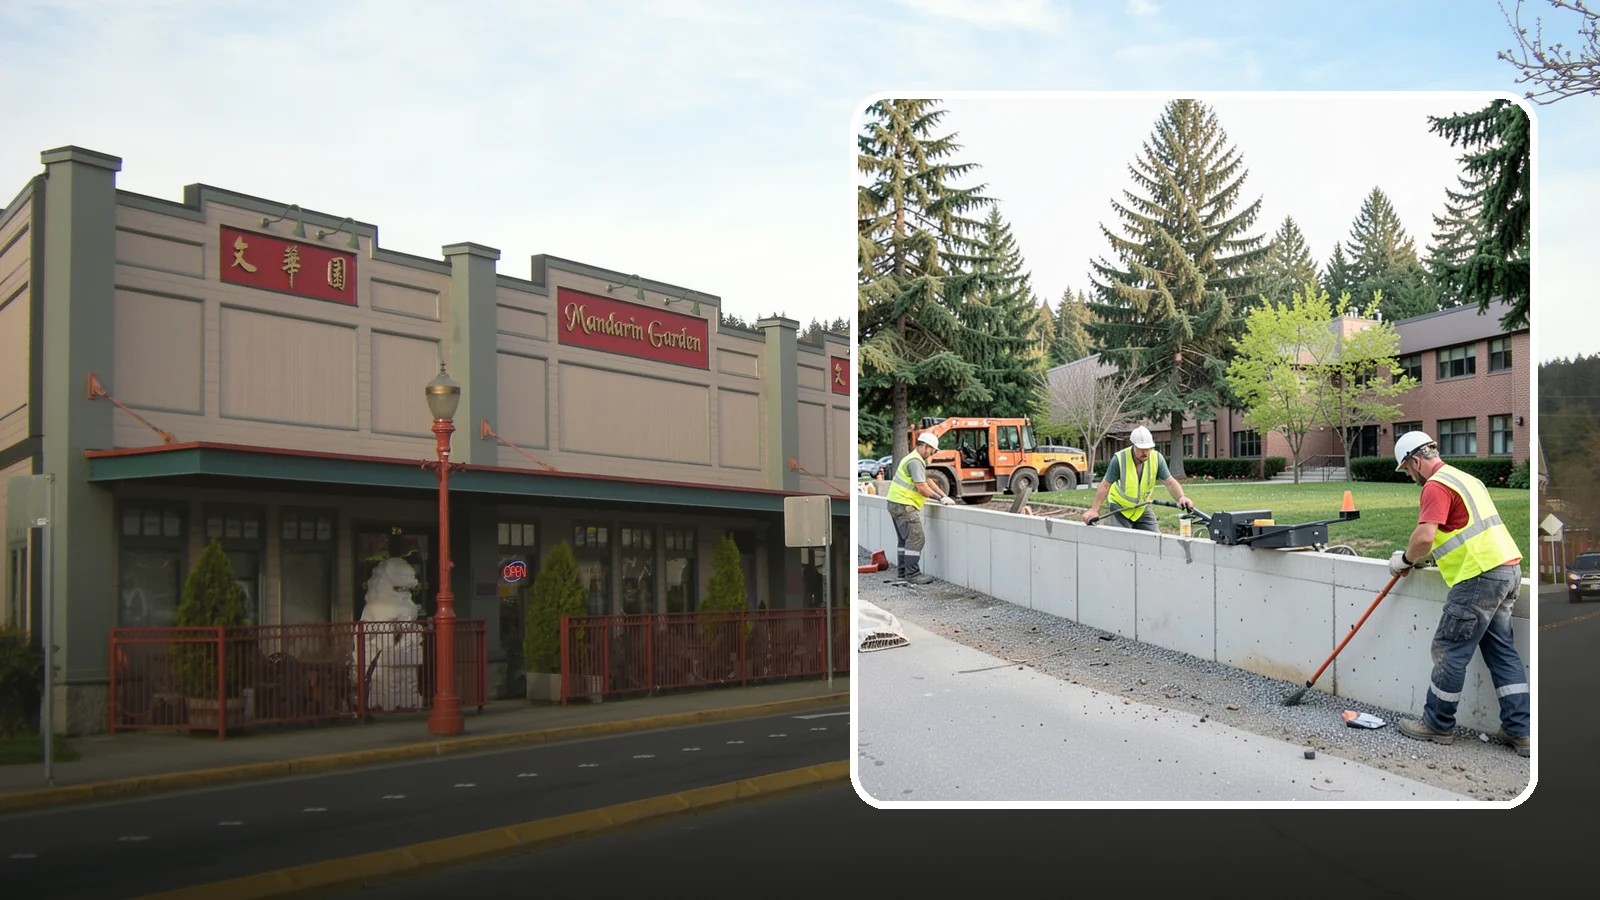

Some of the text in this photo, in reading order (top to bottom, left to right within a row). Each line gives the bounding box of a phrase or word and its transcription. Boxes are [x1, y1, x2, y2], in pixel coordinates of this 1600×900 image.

[231, 236, 346, 291] 文華園
[564, 302, 701, 353] Mandarin Garden
[503, 565, 527, 578] OPEN
